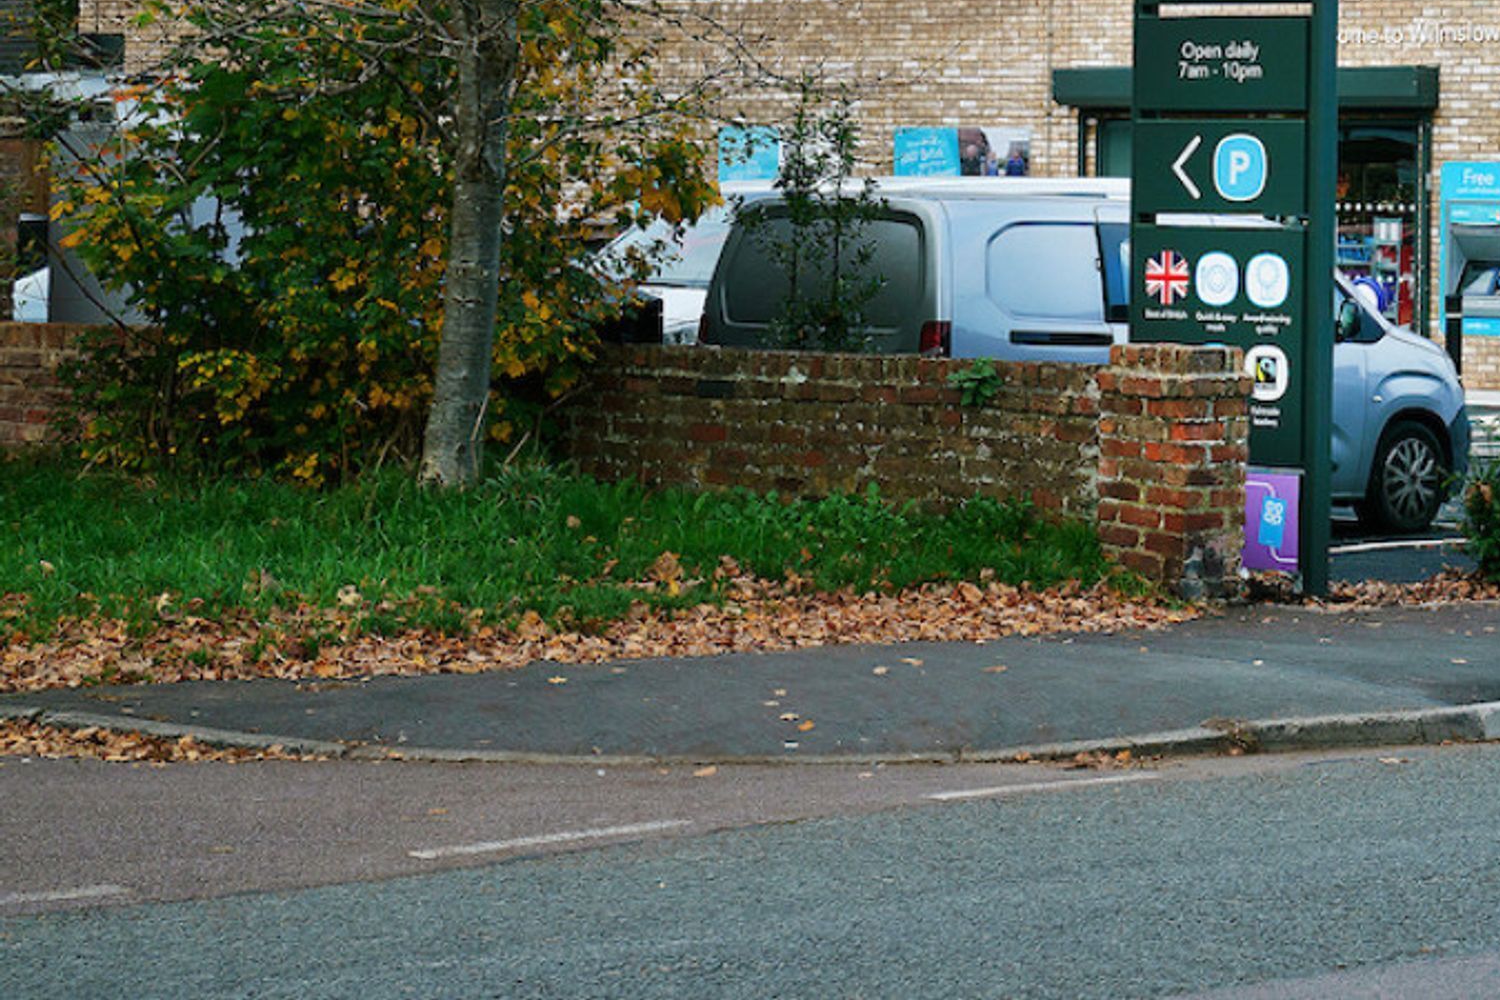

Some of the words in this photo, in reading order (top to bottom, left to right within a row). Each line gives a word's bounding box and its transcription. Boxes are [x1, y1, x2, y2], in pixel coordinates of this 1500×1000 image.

[1181, 40, 1222, 62] Open
[1225, 40, 1260, 62] daily
[1178, 61, 1209, 79] 7am
[1222, 61, 1263, 83] 10pm
[1462, 167, 1495, 186] Free
